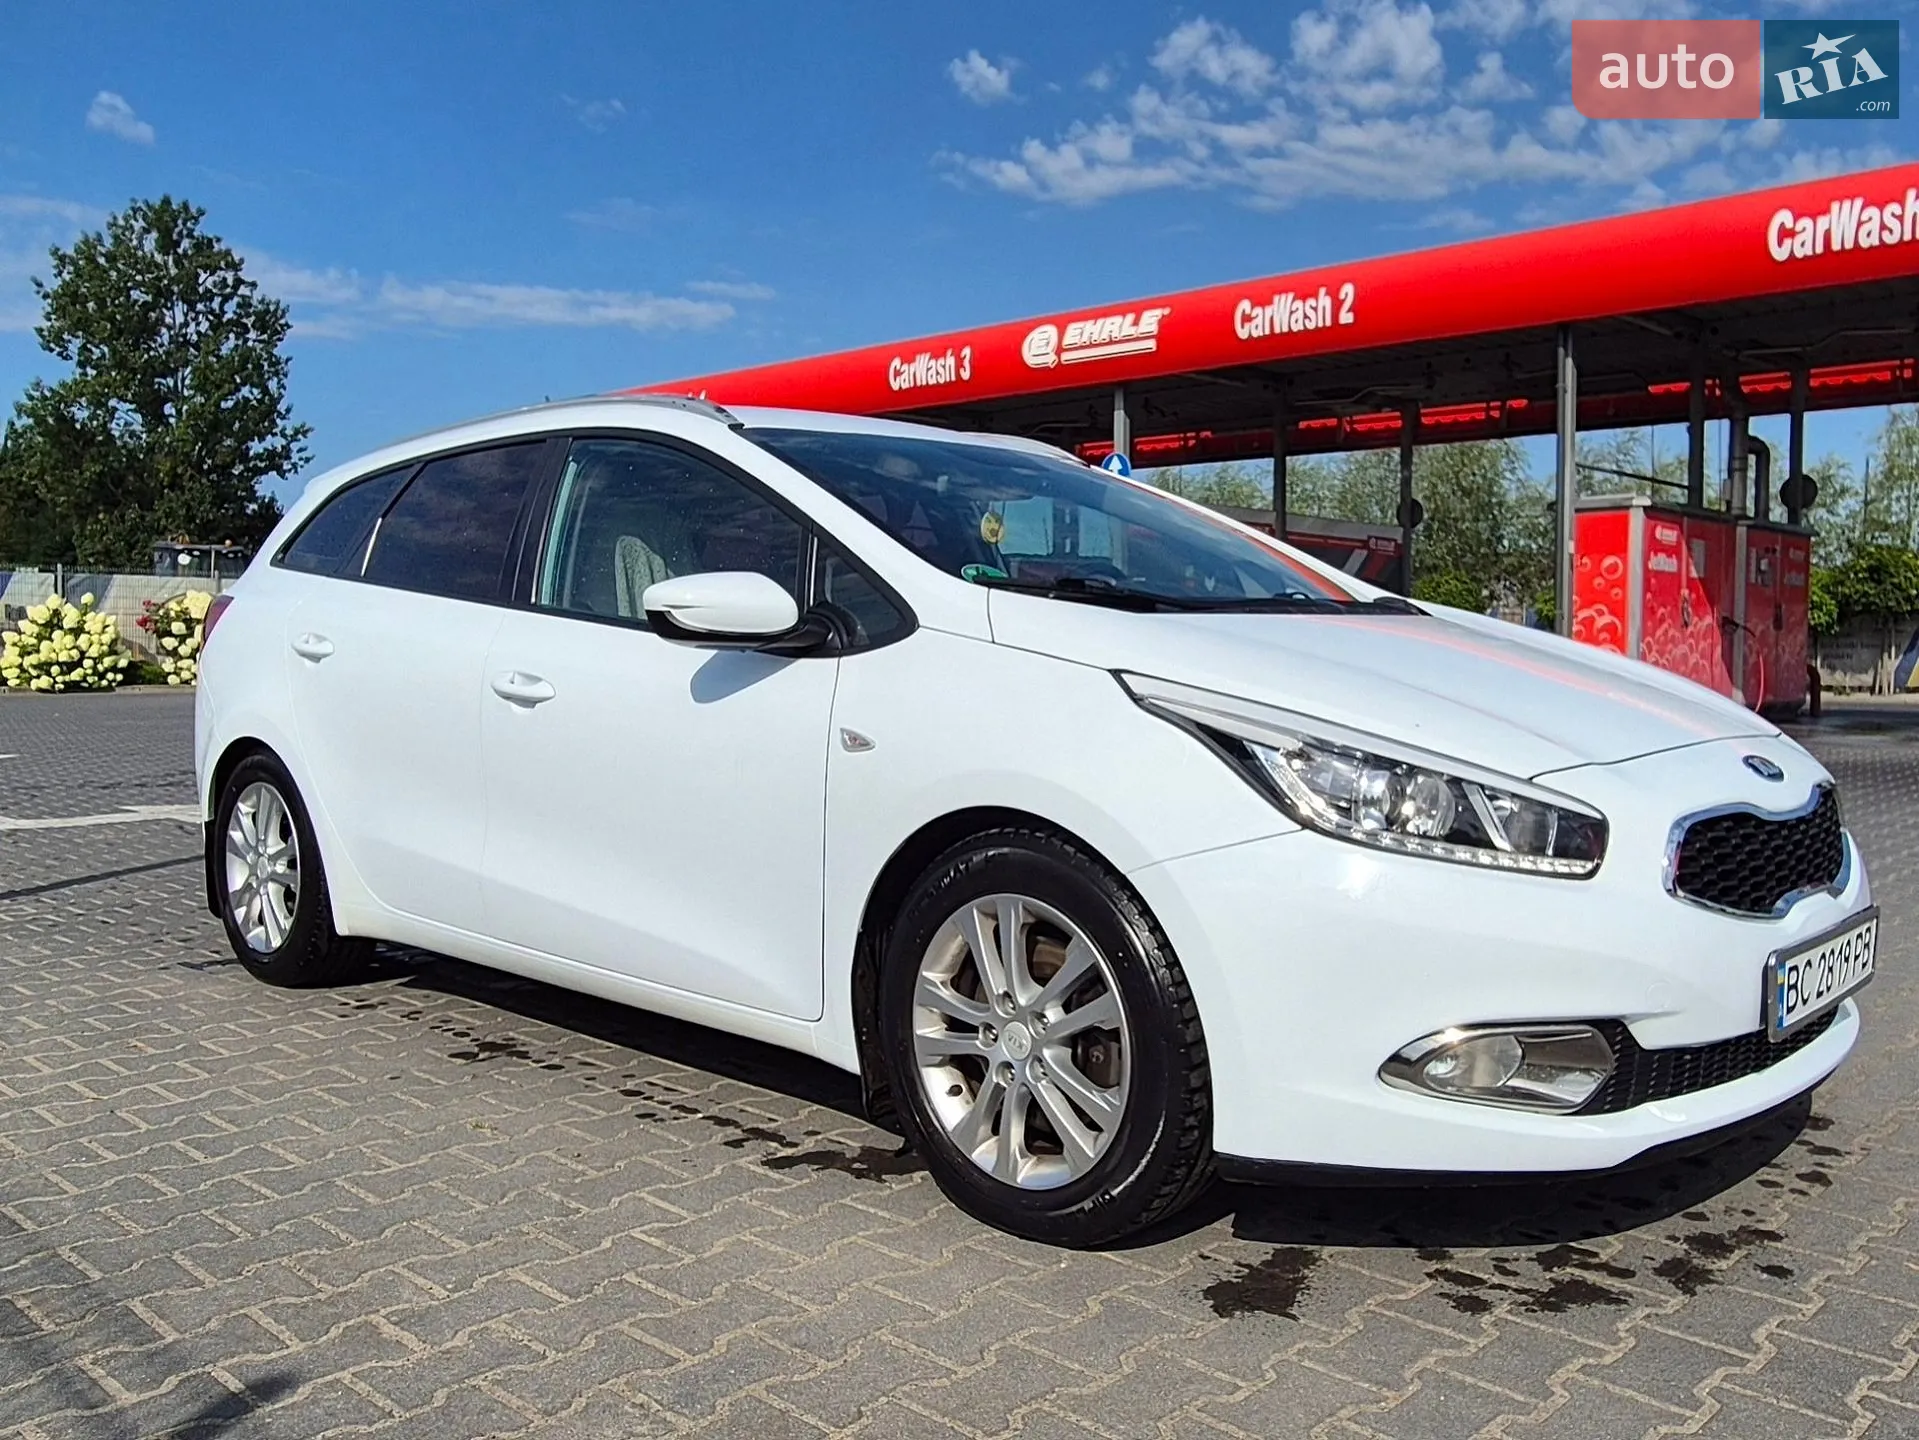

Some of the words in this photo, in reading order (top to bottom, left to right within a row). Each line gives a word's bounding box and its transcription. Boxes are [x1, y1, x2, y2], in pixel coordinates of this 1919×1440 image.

[1767, 187, 1919, 262] CarWash
[1062, 307, 1165, 349] EHRLE
[1233, 286, 1332, 340] CarWash
[1338, 281, 1355, 325] 2
[888, 347, 957, 391] CarWash
[959, 344, 971, 381] 3
[1785, 958, 1813, 1016] BC
[1815, 938, 1852, 1000] 2819
[1852, 925, 1872, 978] PB
